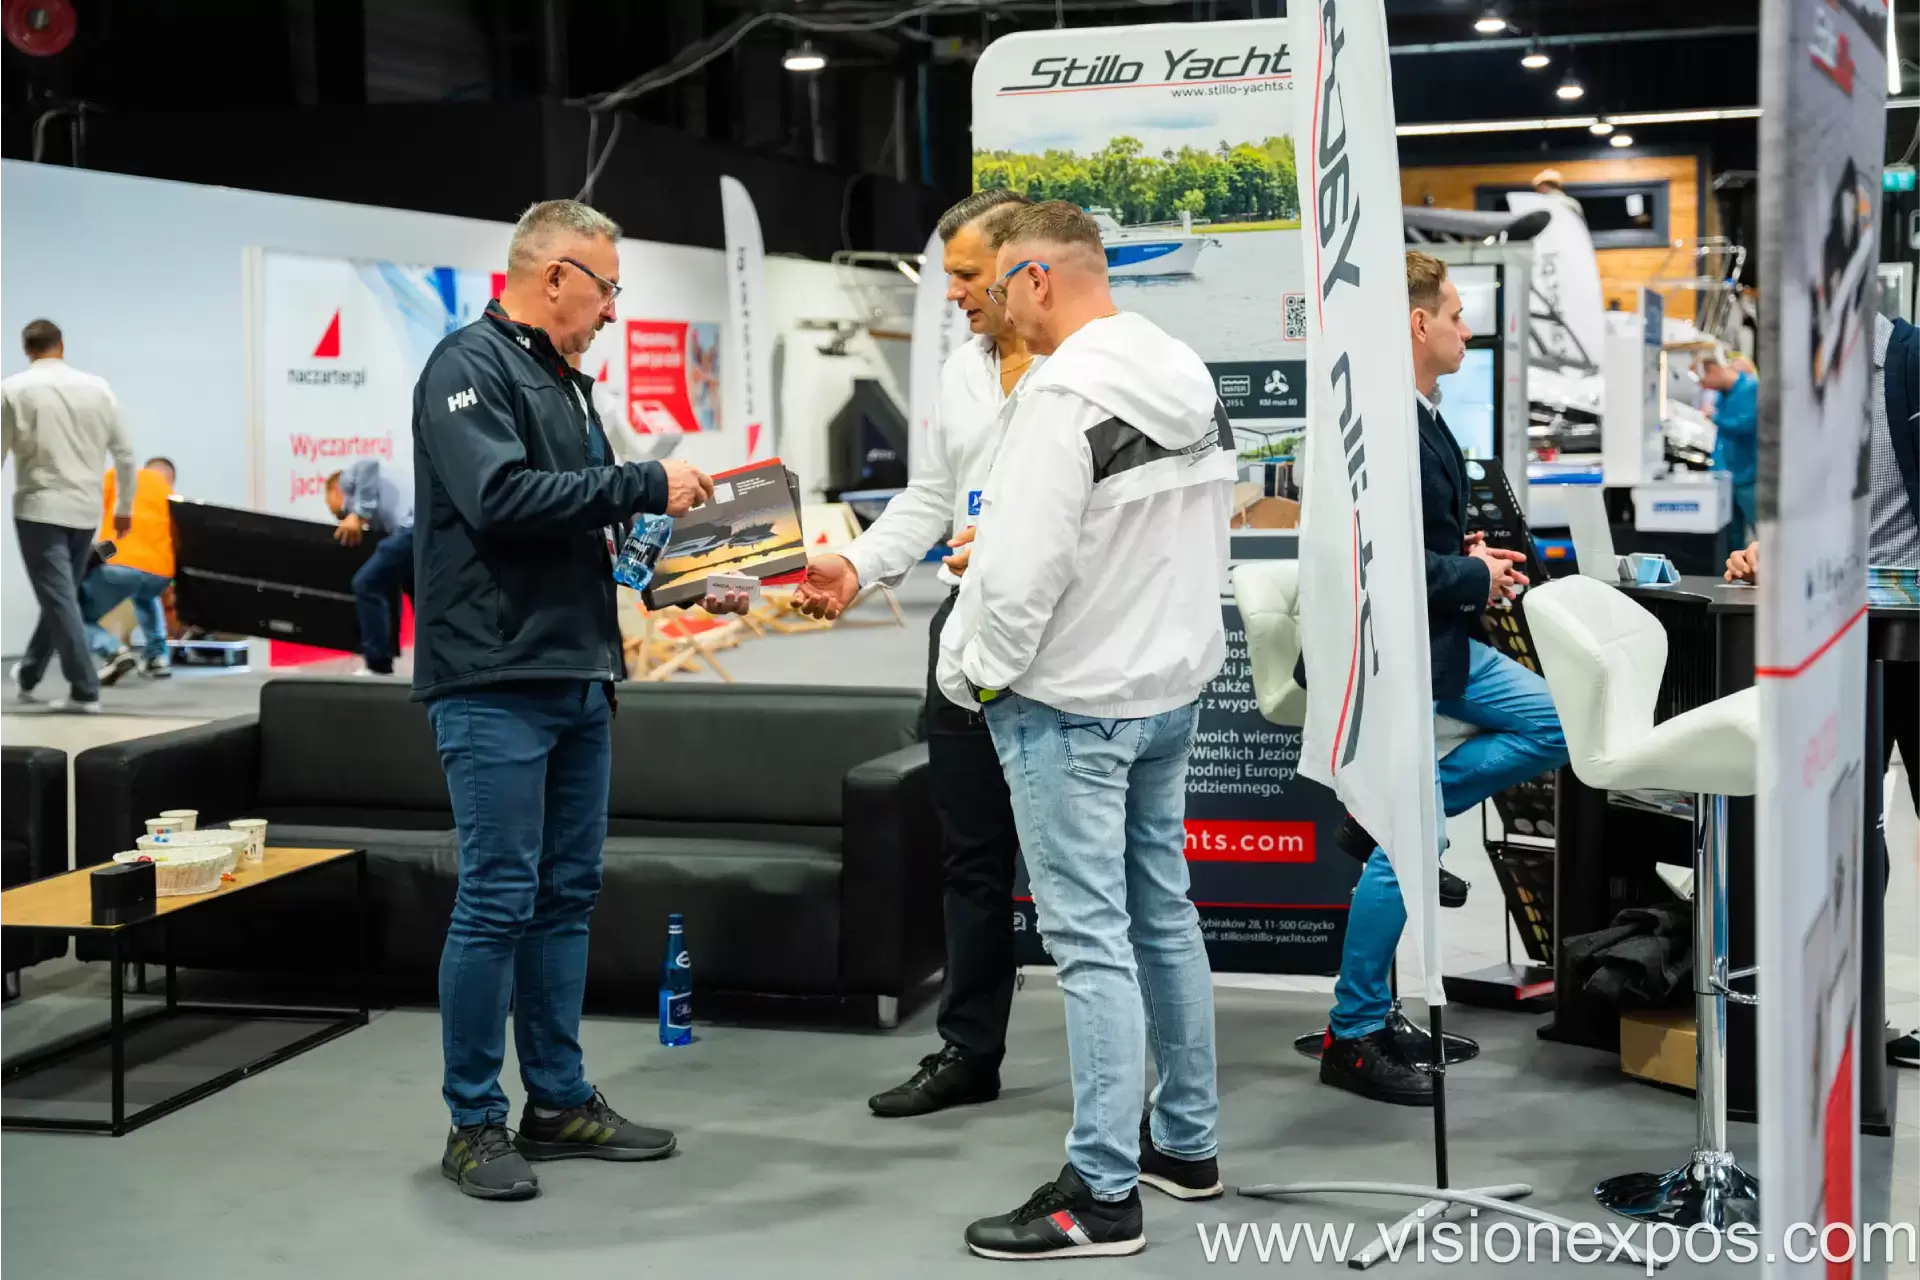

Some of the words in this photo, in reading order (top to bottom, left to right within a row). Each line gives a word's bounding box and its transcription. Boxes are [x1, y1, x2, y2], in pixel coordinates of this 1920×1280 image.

[1000, 54, 1144, 92] Stillo
[1164, 44, 1292, 81] Yacht
[1171, 81, 1294, 98] www.stillo-yachts.c
[287, 366, 366, 388] naczarter.pl
[447, 387, 478, 412] HH
[1240, 662, 1253, 679] ja
[1212, 679, 1251, 694] także
[1207, 700, 1215, 710] z
[1219, 699, 1259, 713] wygo
[1196, 729, 1240, 744] woich
[1243, 730, 1303, 747] wiernyc
[1193, 745, 1254, 760] Wielkich
[1185, 763, 1241, 780] hodniej
[1244, 763, 1297, 781] Europy
[1184, 779, 1284, 798] ródziemnego.
[1185, 830, 1304, 852] hts.com
